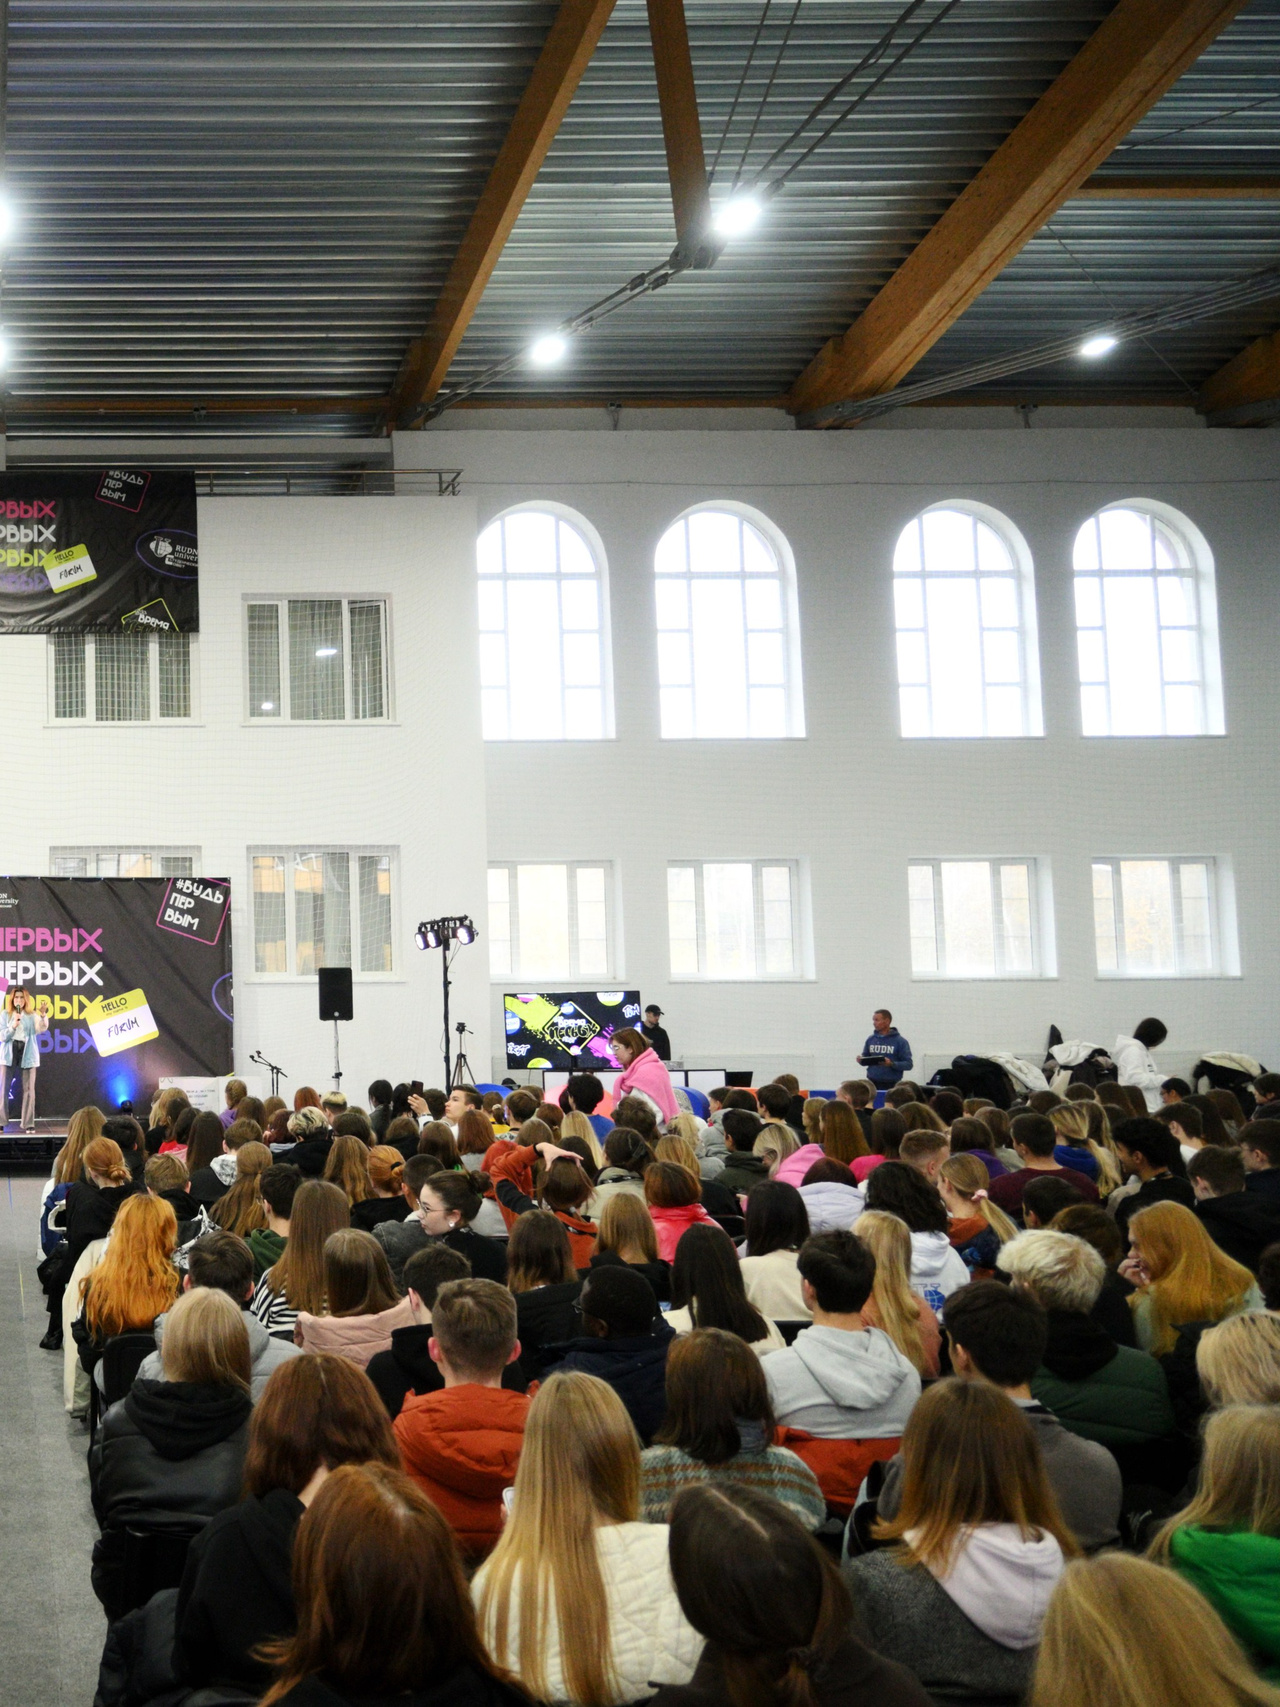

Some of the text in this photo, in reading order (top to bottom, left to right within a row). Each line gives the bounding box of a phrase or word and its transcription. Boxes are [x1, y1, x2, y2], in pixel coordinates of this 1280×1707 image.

[104, 478, 123, 489] ПЕР
[100, 488, 126, 502] ВЫМ
[55, 550, 74, 561] HELLO
[175, 545, 198, 556] RUDN
[59, 565, 83, 580] FORUM
[176, 878, 224, 904] #БУДЬ
[169, 892, 195, 910] ПЕР
[164, 908, 200, 930] ВЫМ
[101, 997, 127, 1013] HELLO
[107, 1017, 140, 1037] FORUM
[869, 1044, 895, 1054] RUDN
